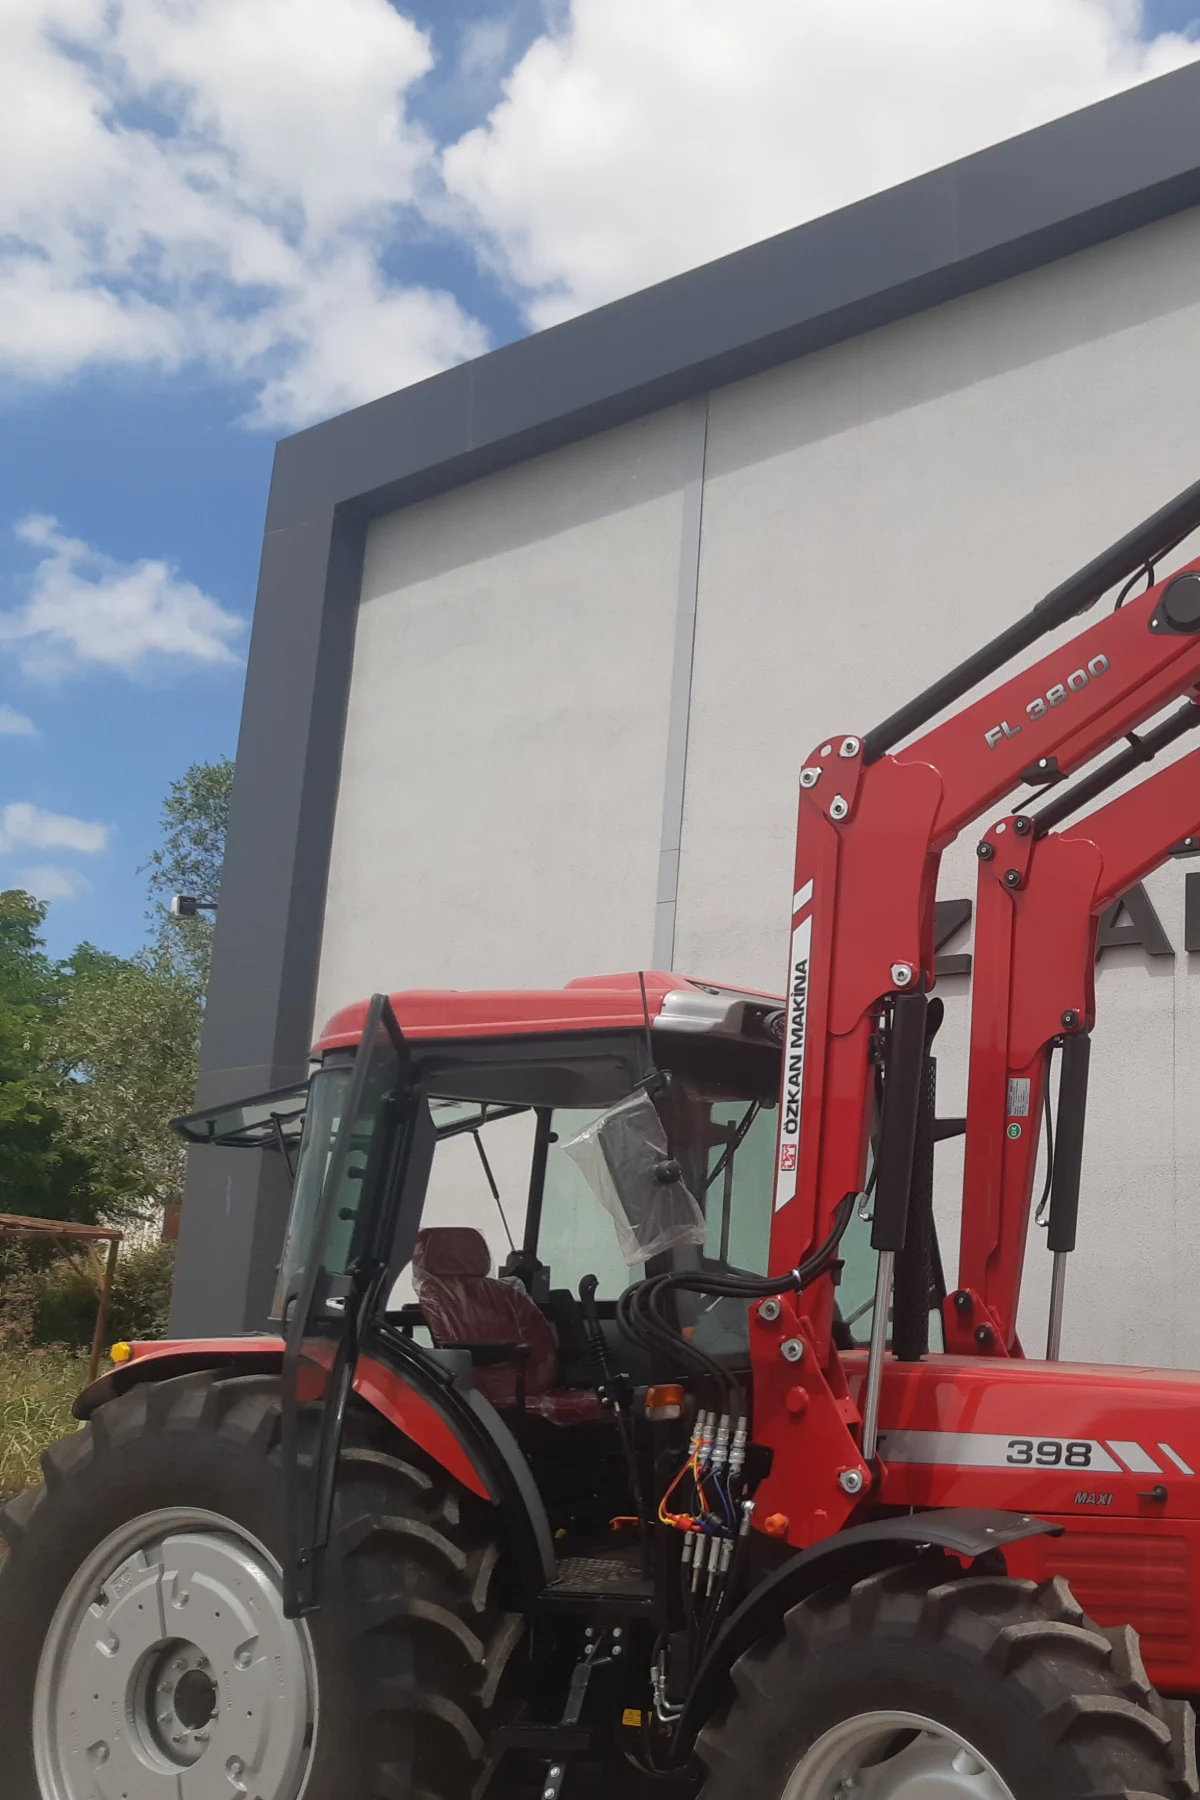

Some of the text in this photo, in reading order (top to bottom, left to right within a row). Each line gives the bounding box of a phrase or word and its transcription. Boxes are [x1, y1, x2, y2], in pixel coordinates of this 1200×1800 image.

[984, 653, 1111, 750] FL 3800
[782, 958, 808, 1135] ÖZKAN MAKİNA
[1006, 1439, 1092, 1467] 398
[1073, 1491, 1115, 1506] MAXI
